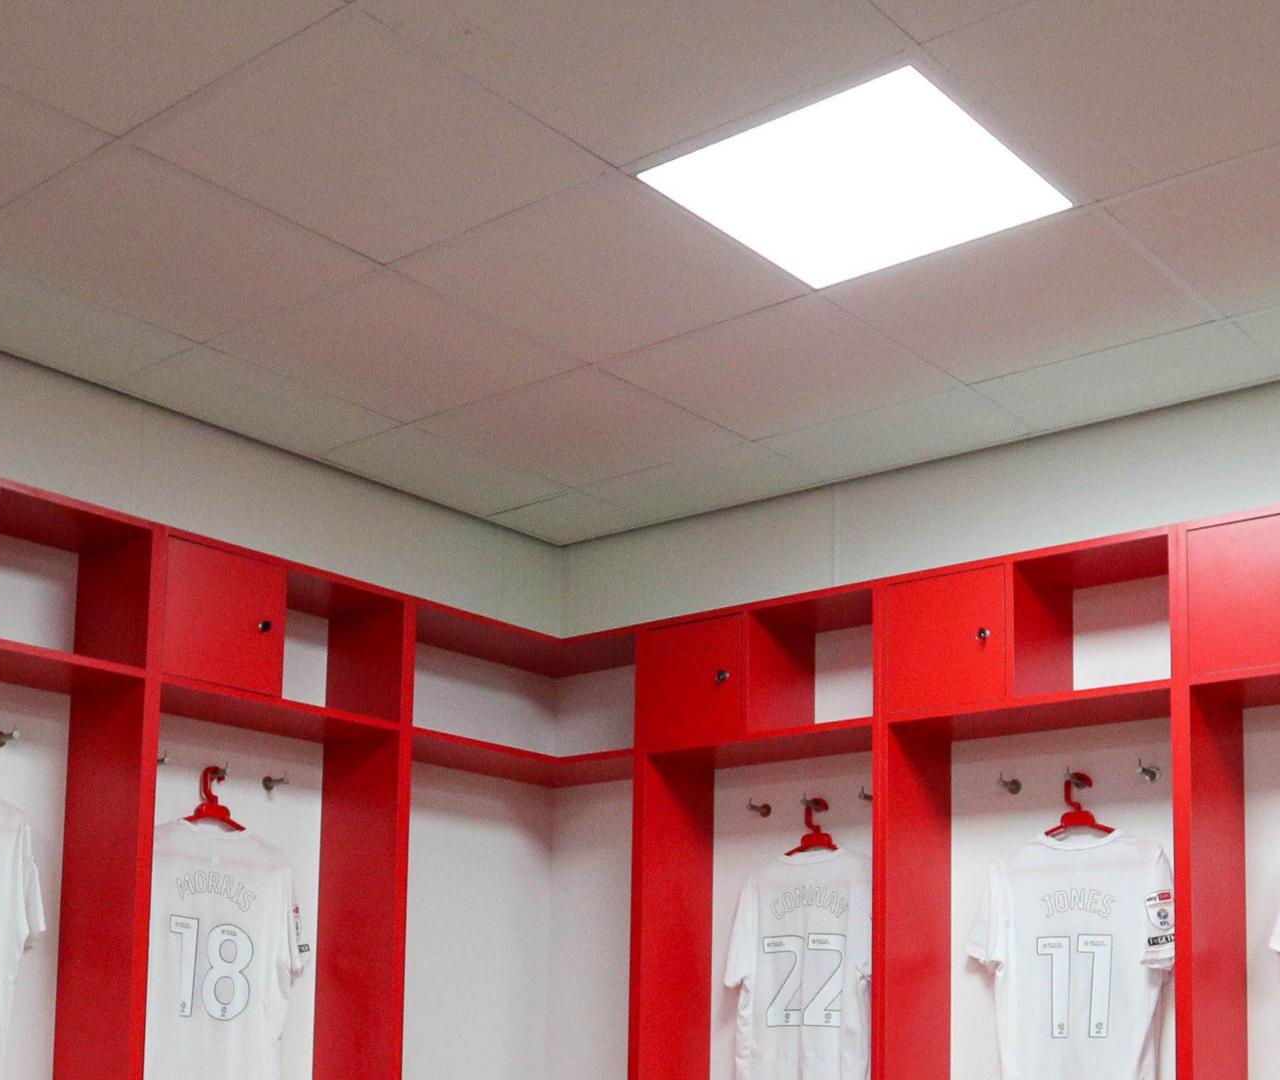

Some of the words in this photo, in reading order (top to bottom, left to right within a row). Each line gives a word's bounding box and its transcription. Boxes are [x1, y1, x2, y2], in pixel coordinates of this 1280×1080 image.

[176, 870, 257, 913] MORRIS
[1041, 887, 1116, 919] JONES
[169, 913, 254, 1022] 18
[762, 932, 847, 1028] 22
[1036, 933, 1113, 1039] 11
